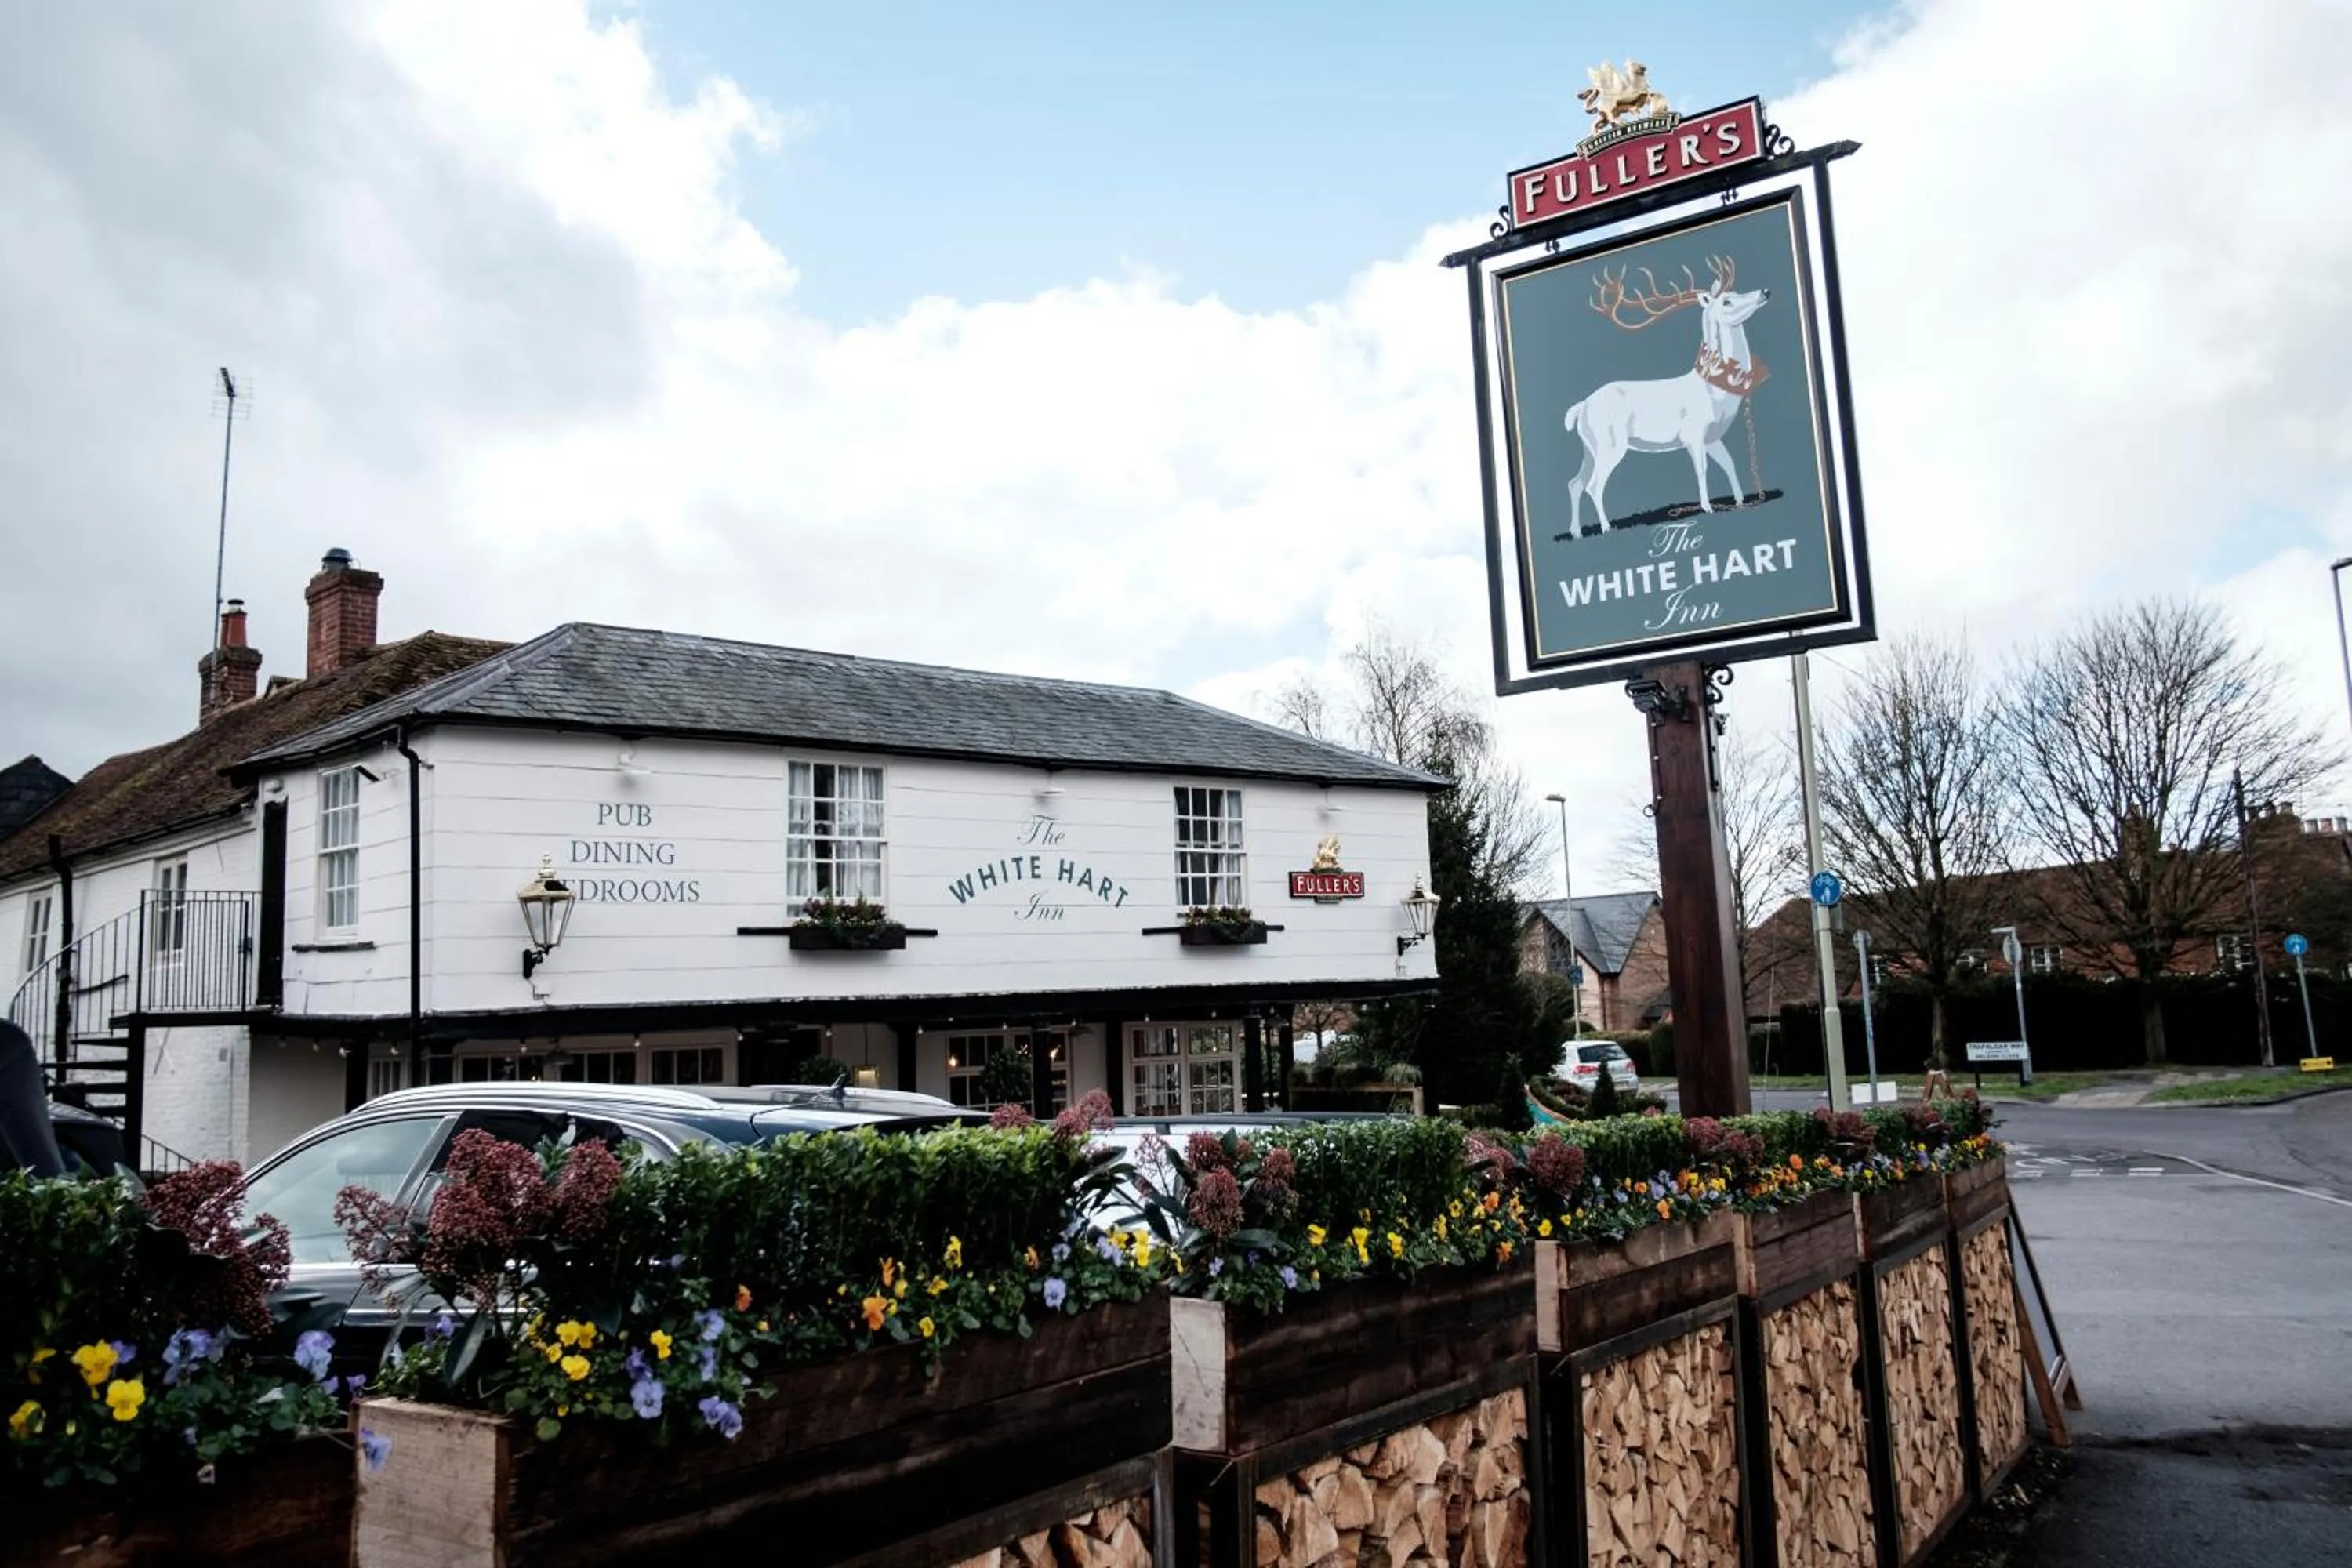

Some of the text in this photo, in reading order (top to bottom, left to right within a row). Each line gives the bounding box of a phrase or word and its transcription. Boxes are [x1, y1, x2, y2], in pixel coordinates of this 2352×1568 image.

[1523, 121, 1742, 213] FULLER'S
[1648, 521, 1704, 557] The
[1559, 539, 1797, 608] WHITE HART
[1644, 584, 1723, 630] Inn
[597, 803, 652, 826] PUB
[1017, 815, 1066, 845] The
[570, 840, 676, 865] DINING
[560, 879, 701, 902] DROOMS
[948, 855, 1129, 909] WHITE HART
[1297, 876, 1360, 893] FULLER'S
[1014, 891, 1065, 920] Inn
